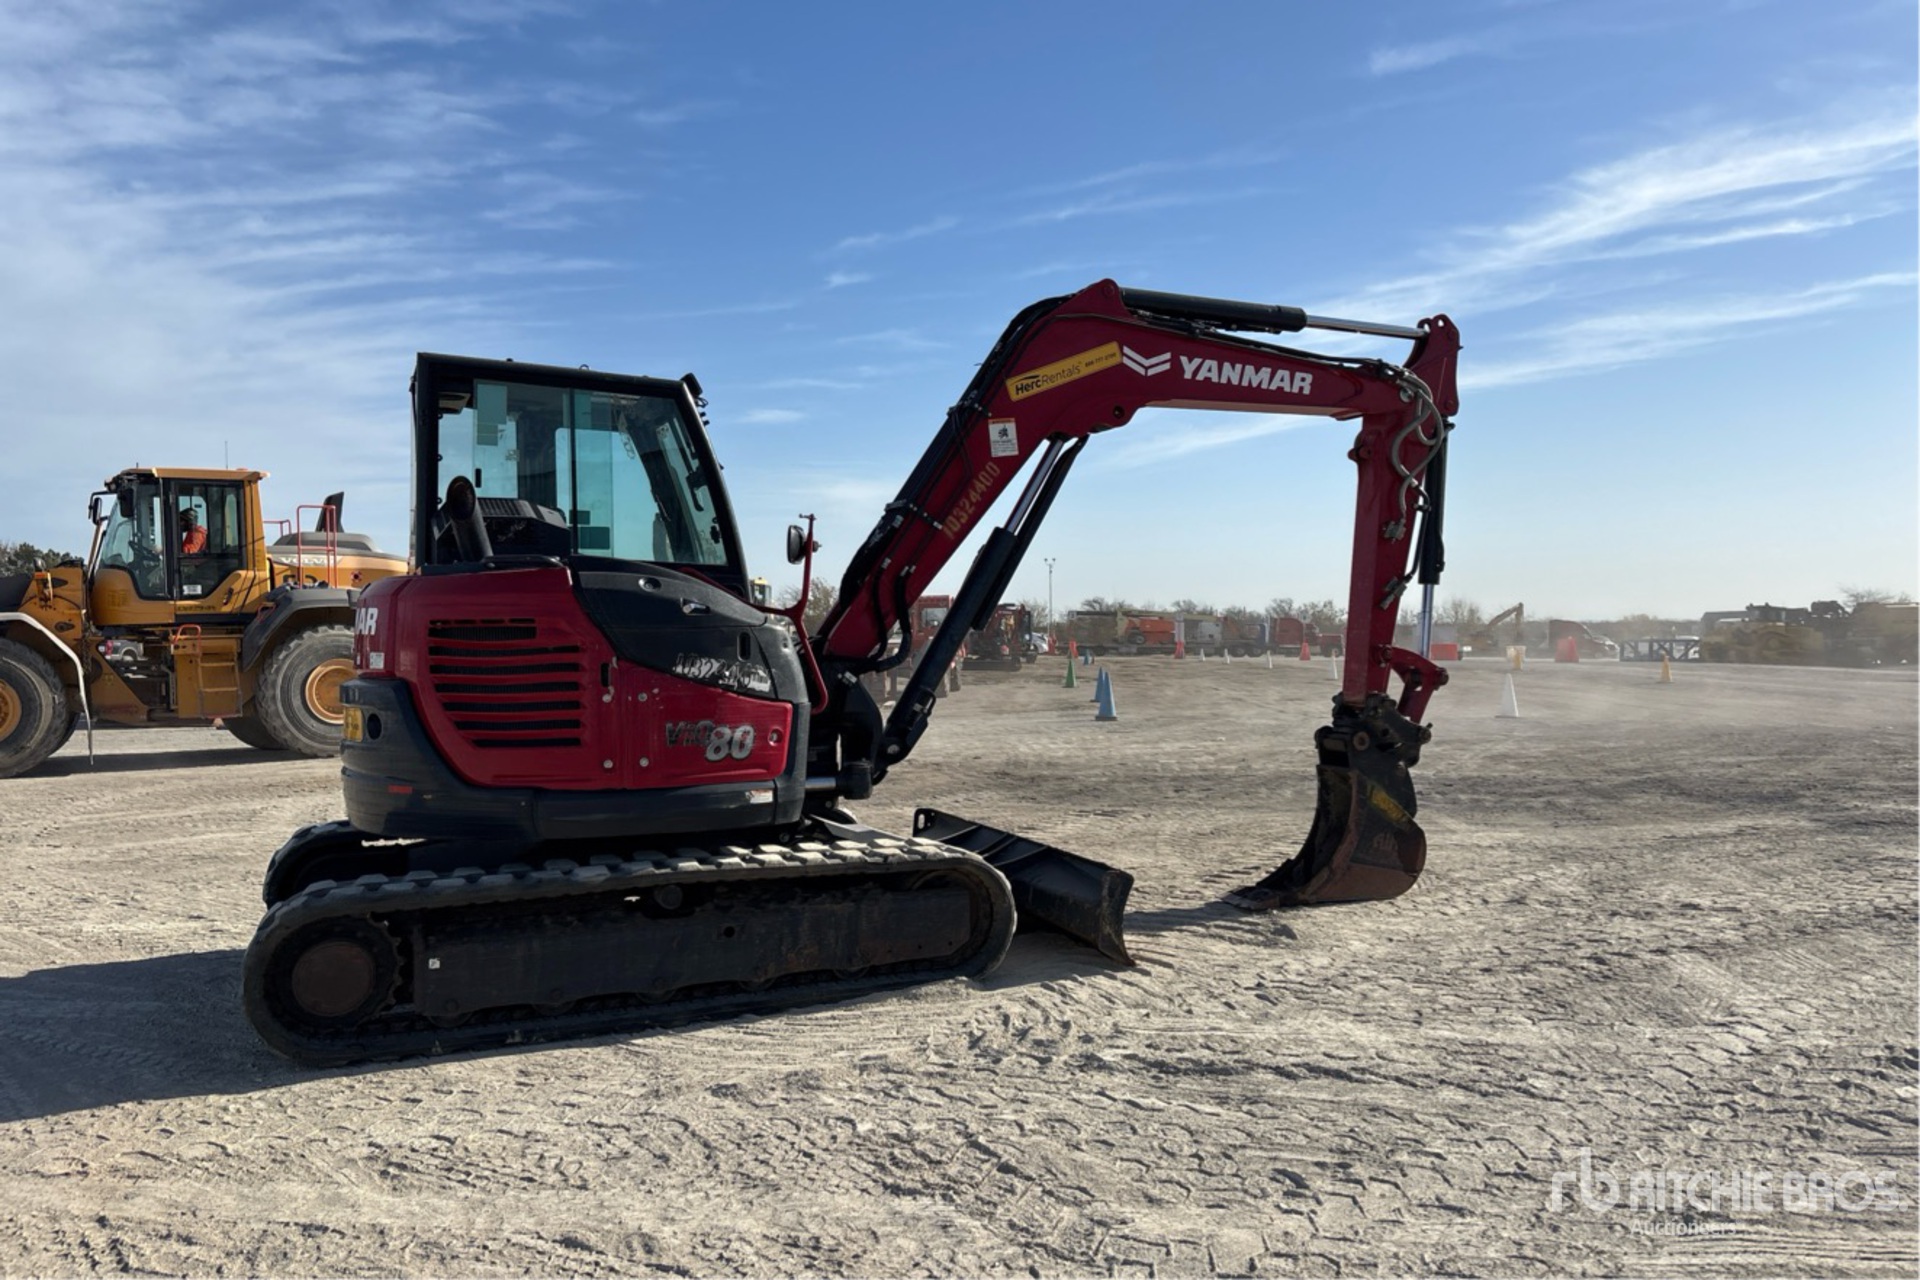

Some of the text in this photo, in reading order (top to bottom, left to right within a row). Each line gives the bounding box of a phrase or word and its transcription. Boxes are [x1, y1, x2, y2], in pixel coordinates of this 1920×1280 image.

[1180, 355, 1313, 395] YANMAR
[943, 461, 1000, 539] 10324400
[355, 607, 378, 635] AR
